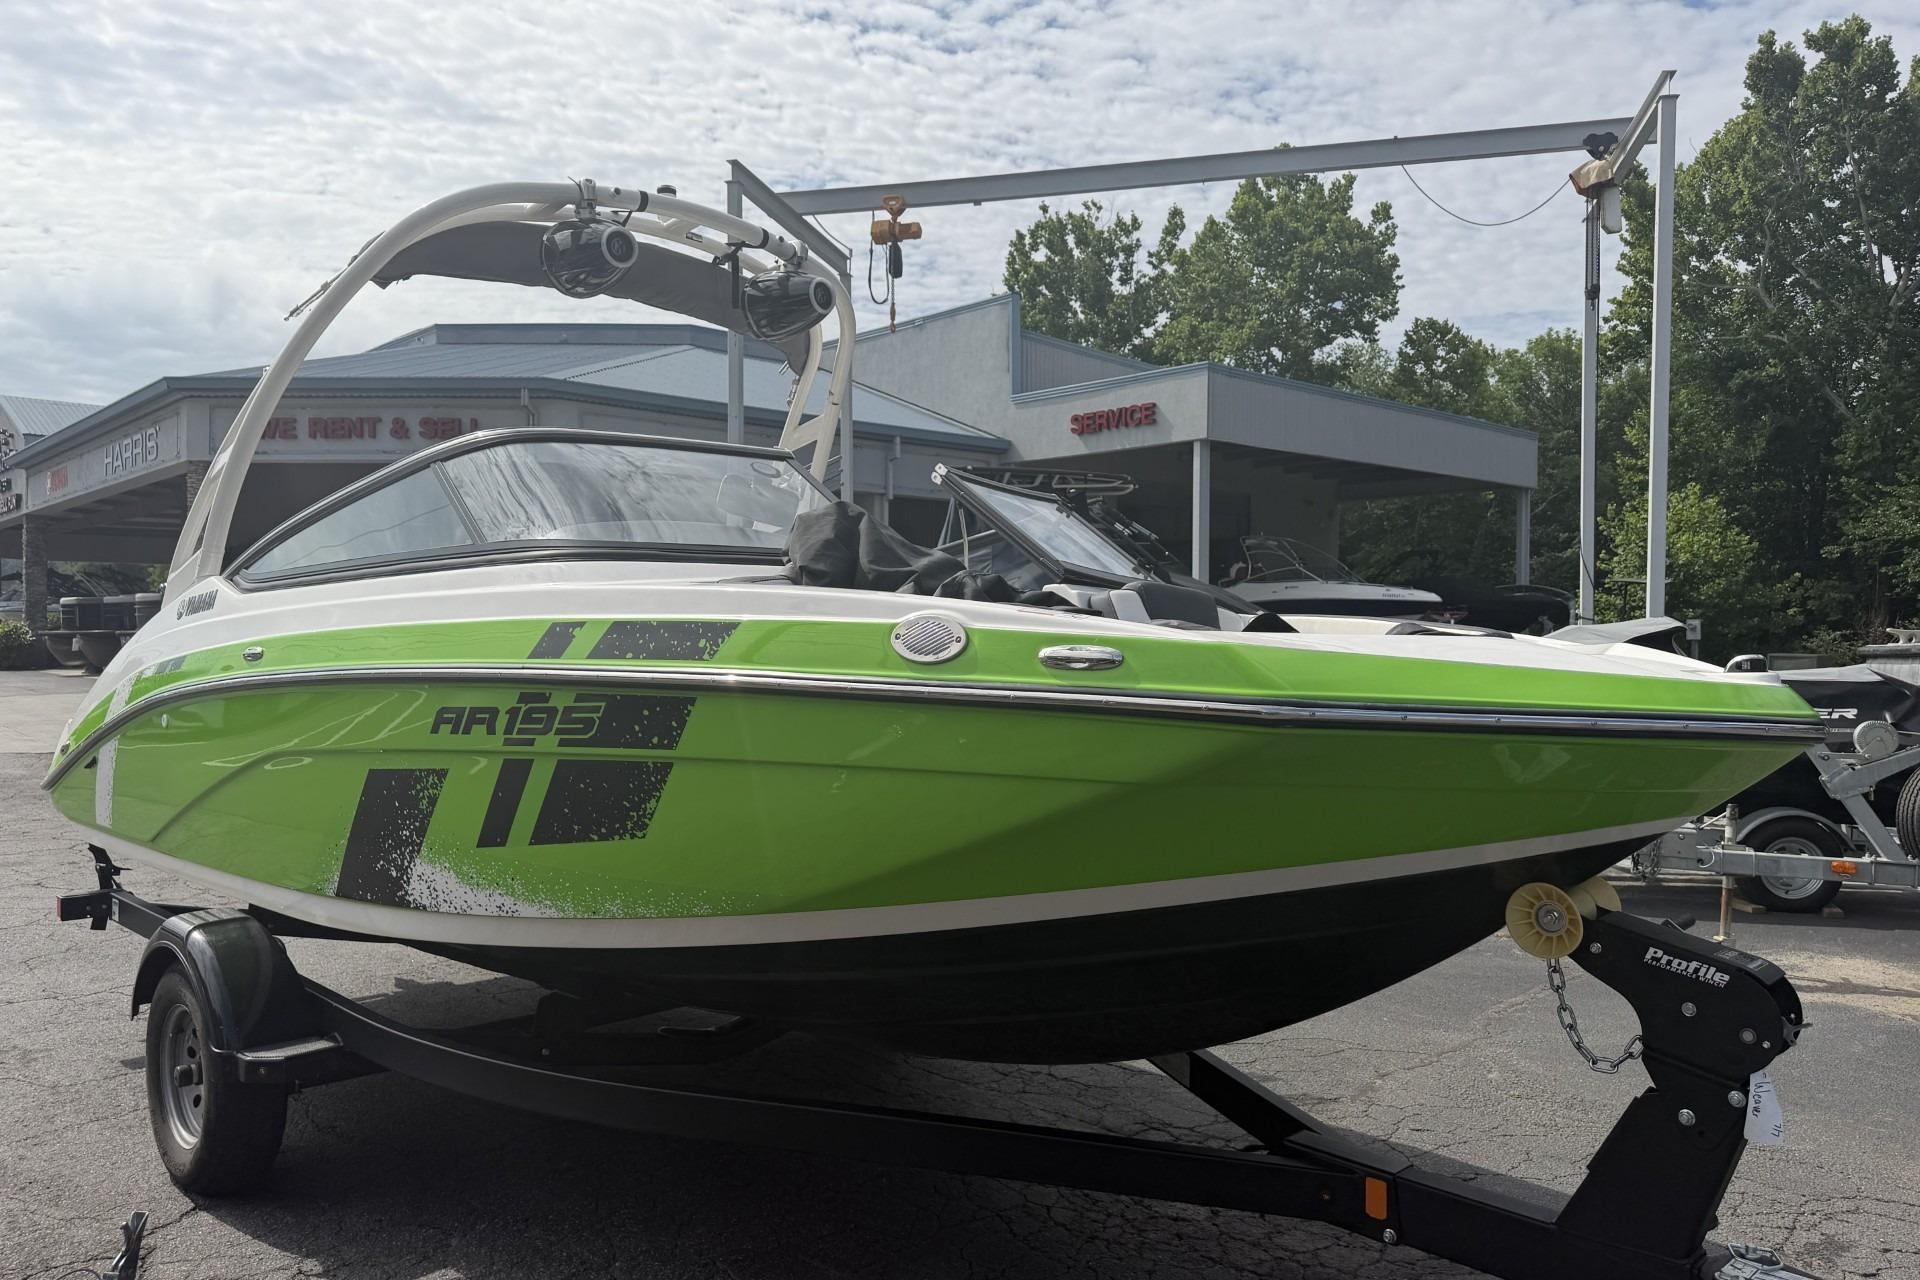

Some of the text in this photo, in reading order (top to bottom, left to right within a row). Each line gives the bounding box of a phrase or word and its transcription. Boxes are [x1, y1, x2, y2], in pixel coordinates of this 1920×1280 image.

[308, 416, 382, 440] RENT
[390, 416, 410, 440] &
[1070, 402, 1157, 435] SERVICE
[429, 703, 605, 737] AR195
[1643, 958, 1697, 979] PERFORMANCE
[1698, 975, 1726, 988] WINCH
[1644, 946, 1731, 983] Profile
